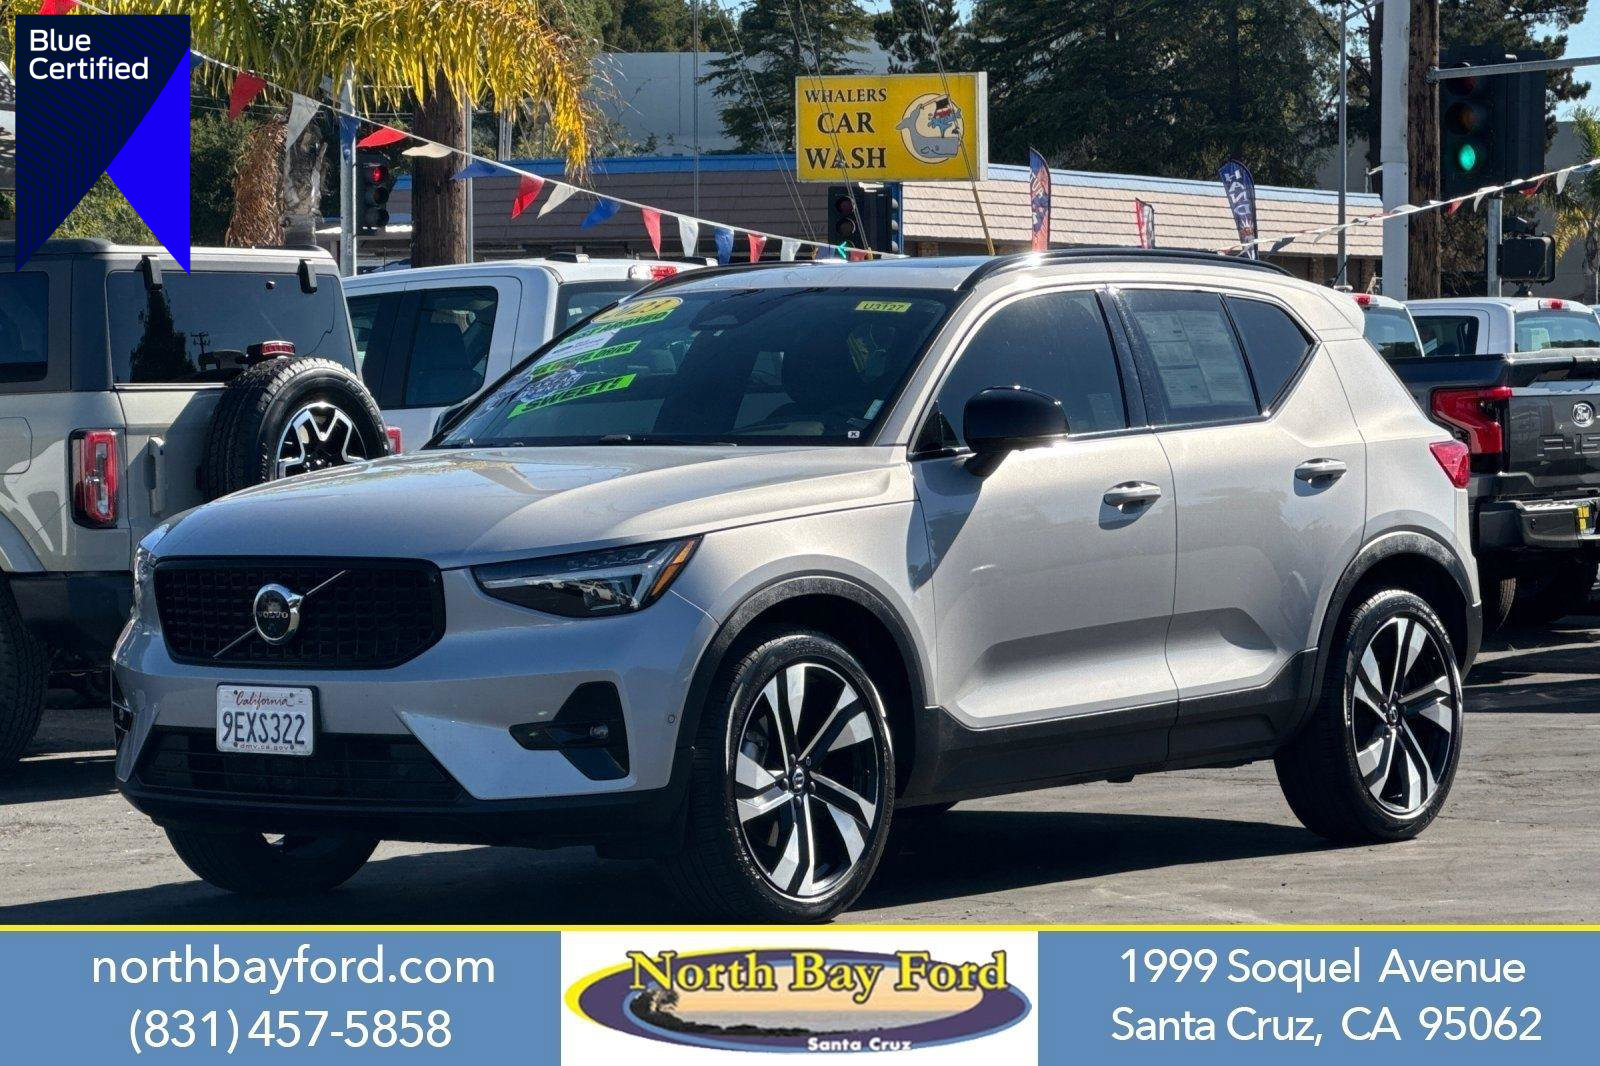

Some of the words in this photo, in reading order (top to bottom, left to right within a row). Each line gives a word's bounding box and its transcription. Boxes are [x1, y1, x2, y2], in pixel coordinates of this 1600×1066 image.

[805, 88, 888, 103] WHALERS
[817, 112, 875, 134] CAR
[804, 147, 887, 170] WASH
[236, 691, 294, 710] California
[222, 711, 305, 745] 9EXS322
